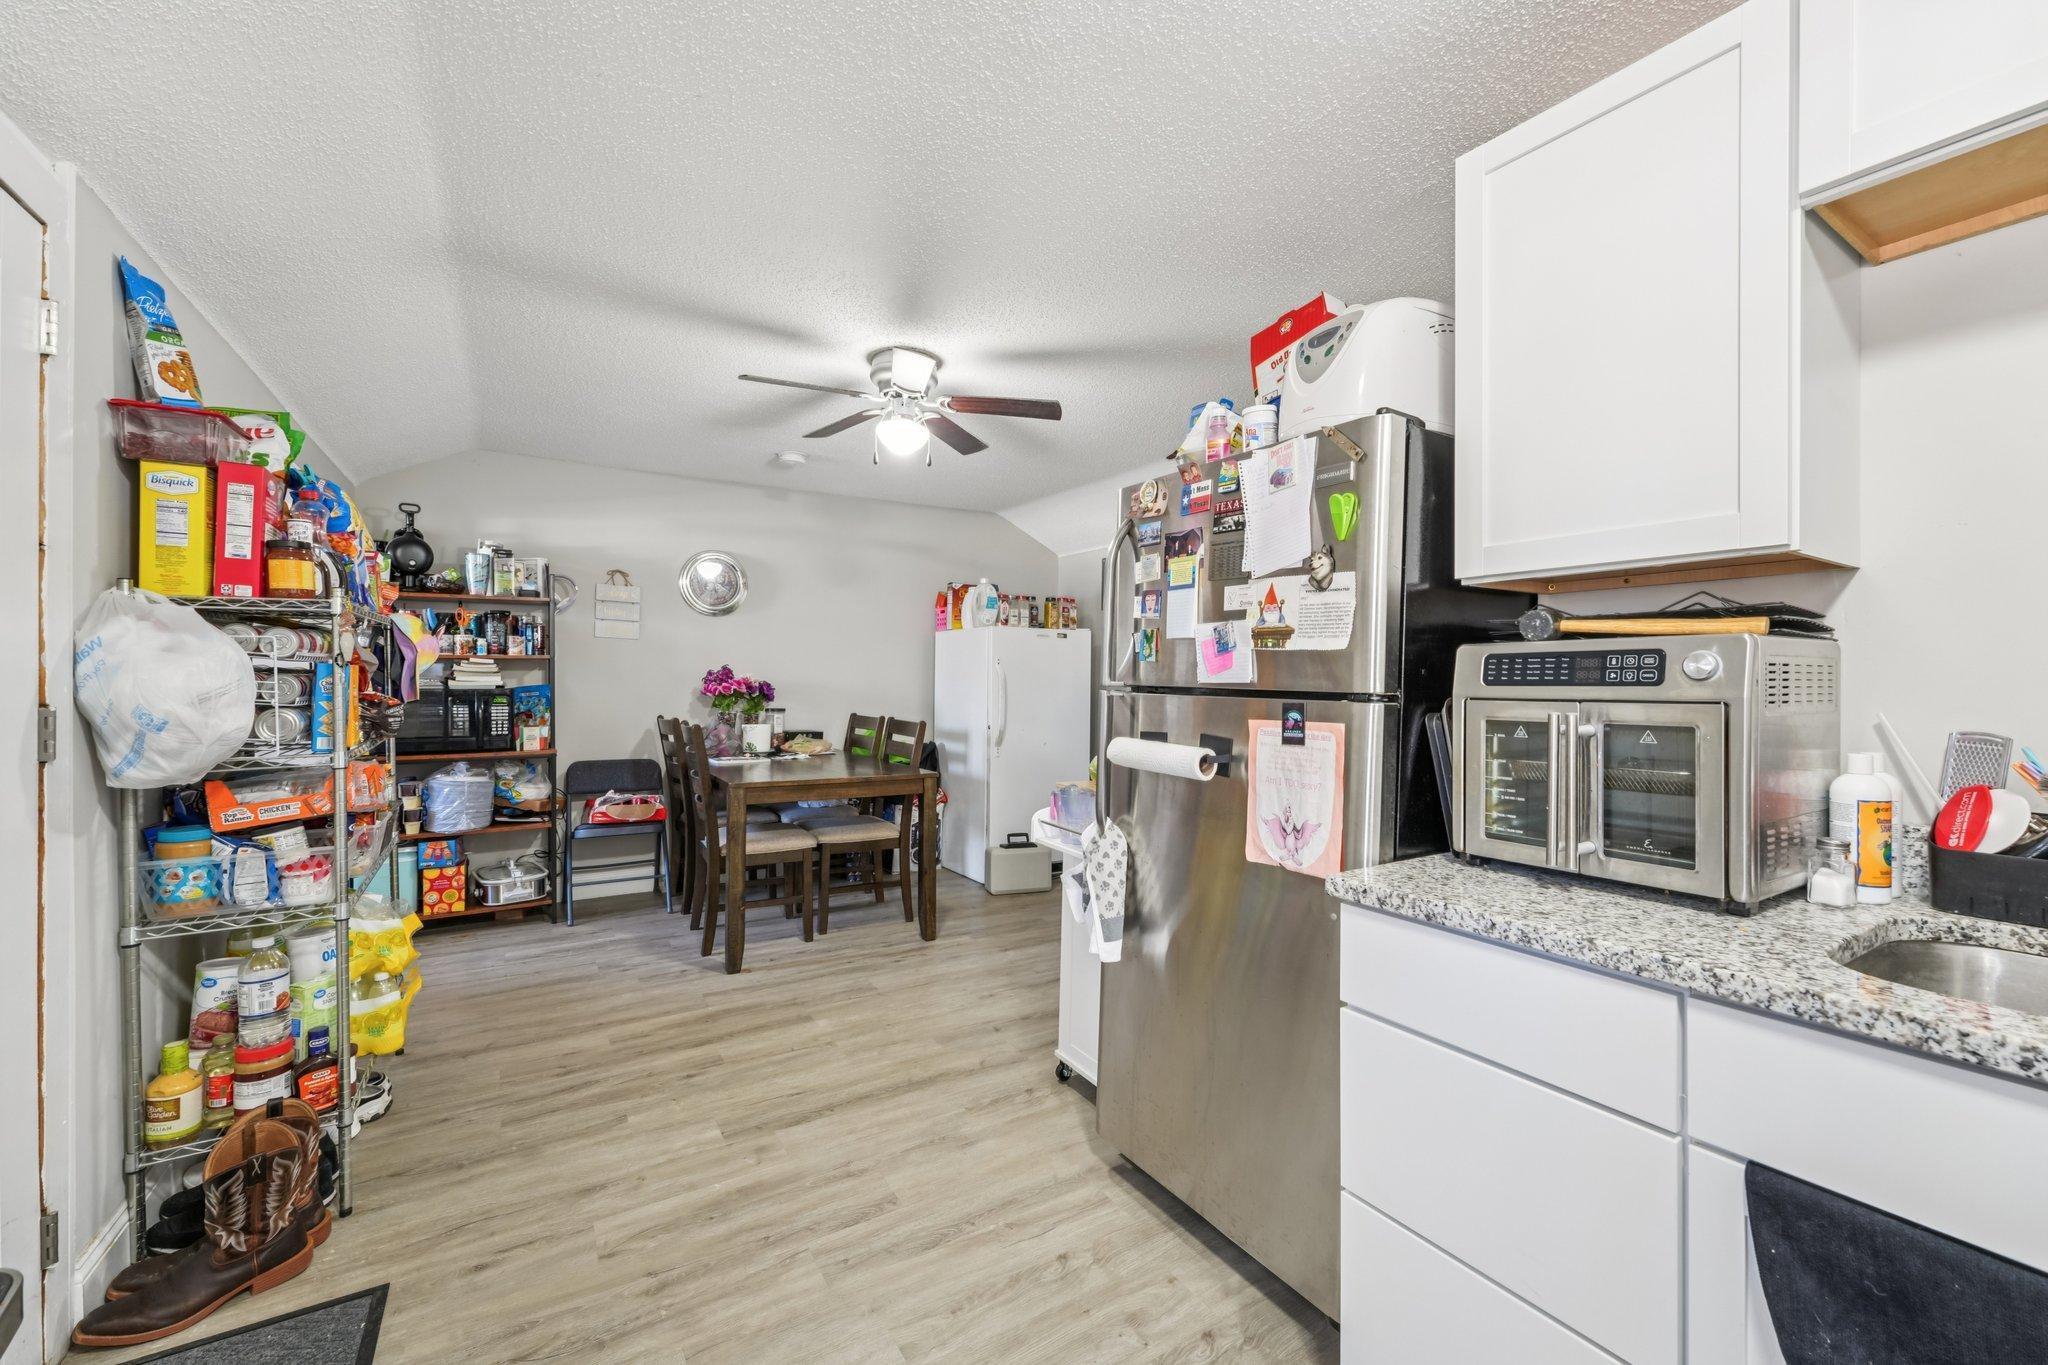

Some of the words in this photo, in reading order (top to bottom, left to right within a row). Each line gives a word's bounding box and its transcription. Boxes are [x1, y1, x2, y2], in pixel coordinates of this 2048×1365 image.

[151, 475, 195, 488] Bisquick
[259, 804, 291, 815] CHICKEN
[222, 812, 238, 820] Top
[224, 815, 252, 823] Ramen
